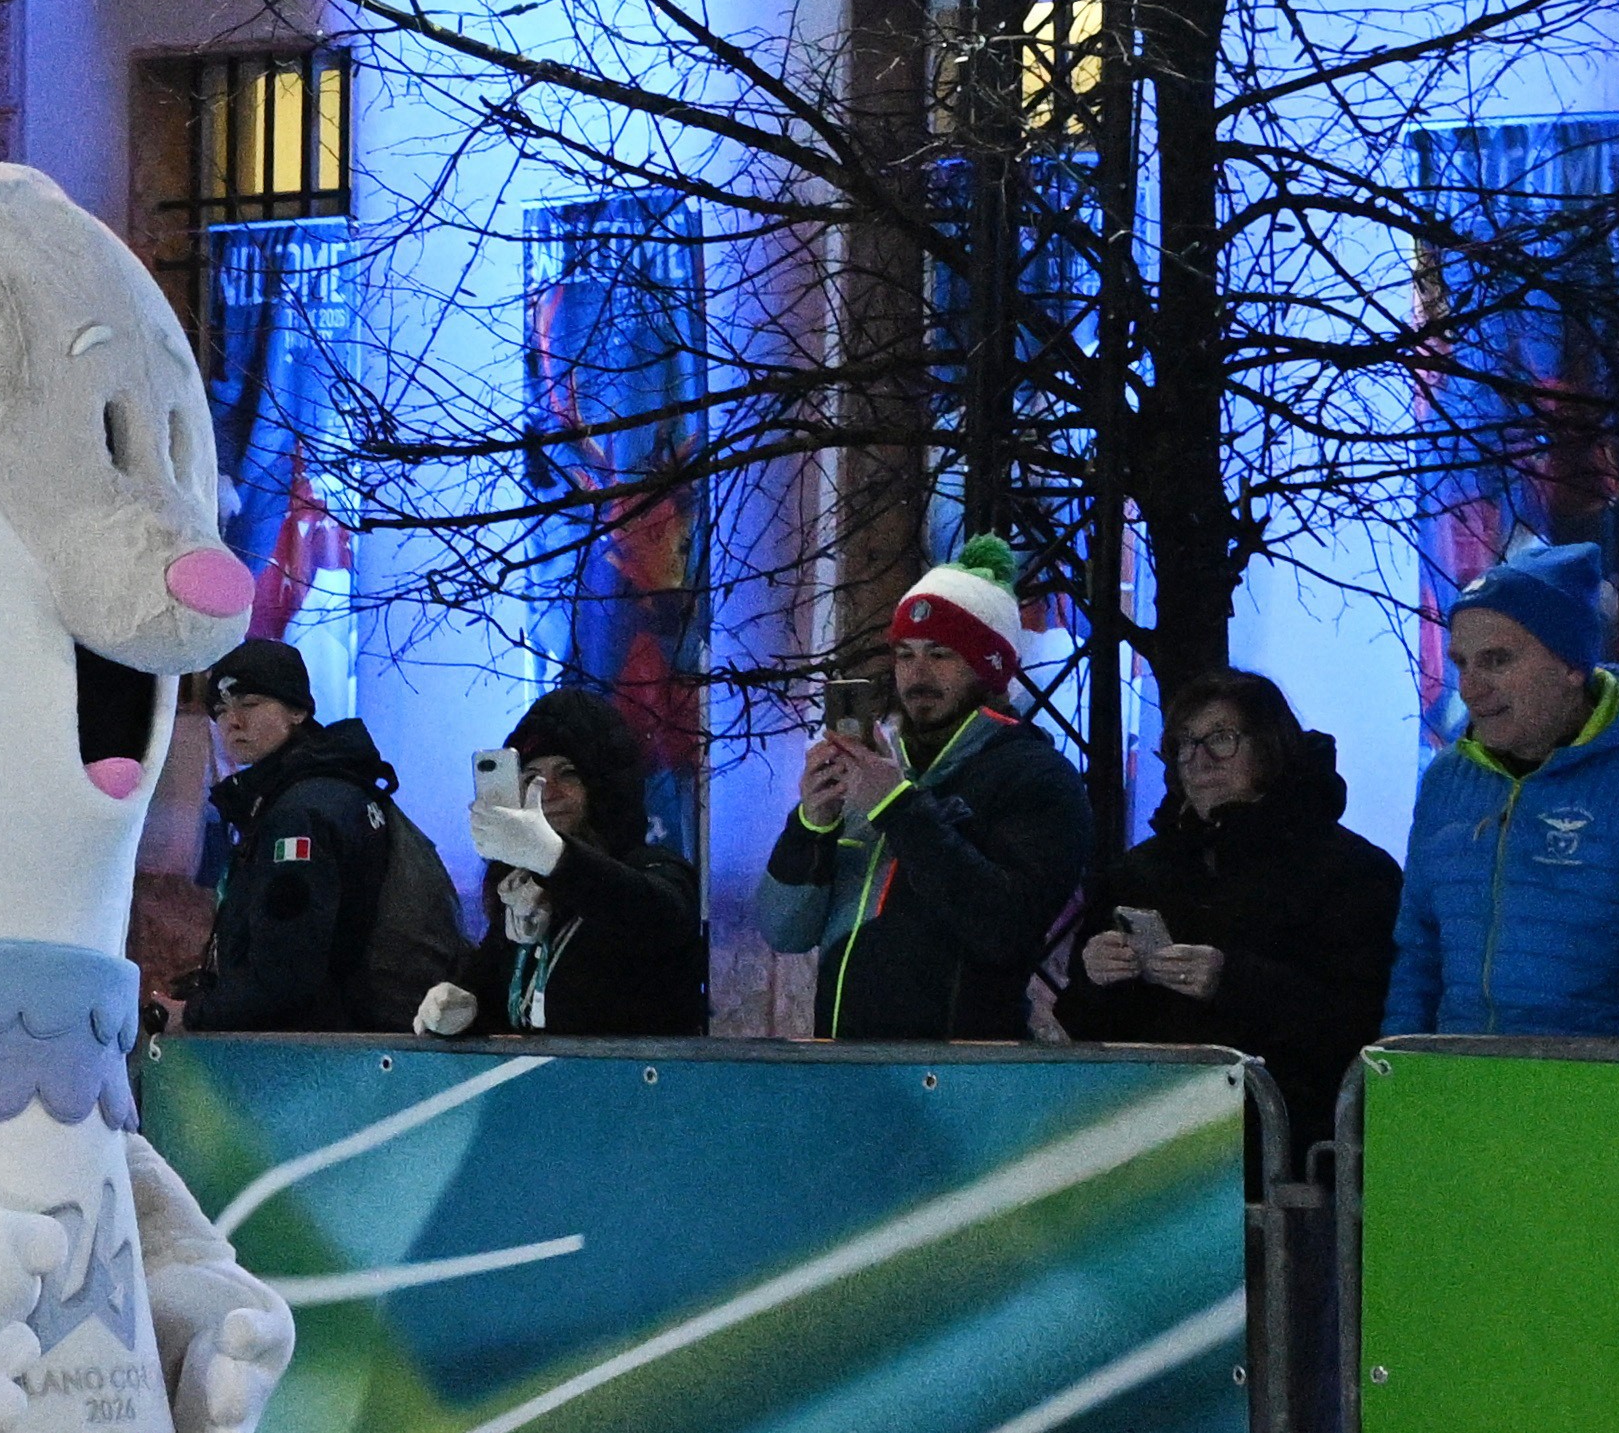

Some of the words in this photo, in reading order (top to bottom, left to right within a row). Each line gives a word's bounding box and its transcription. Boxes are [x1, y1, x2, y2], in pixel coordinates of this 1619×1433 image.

[220, 242, 347, 307] WELOME
[529, 214, 687, 287] WLCOME
[85, 1398, 137, 1422] 2026
